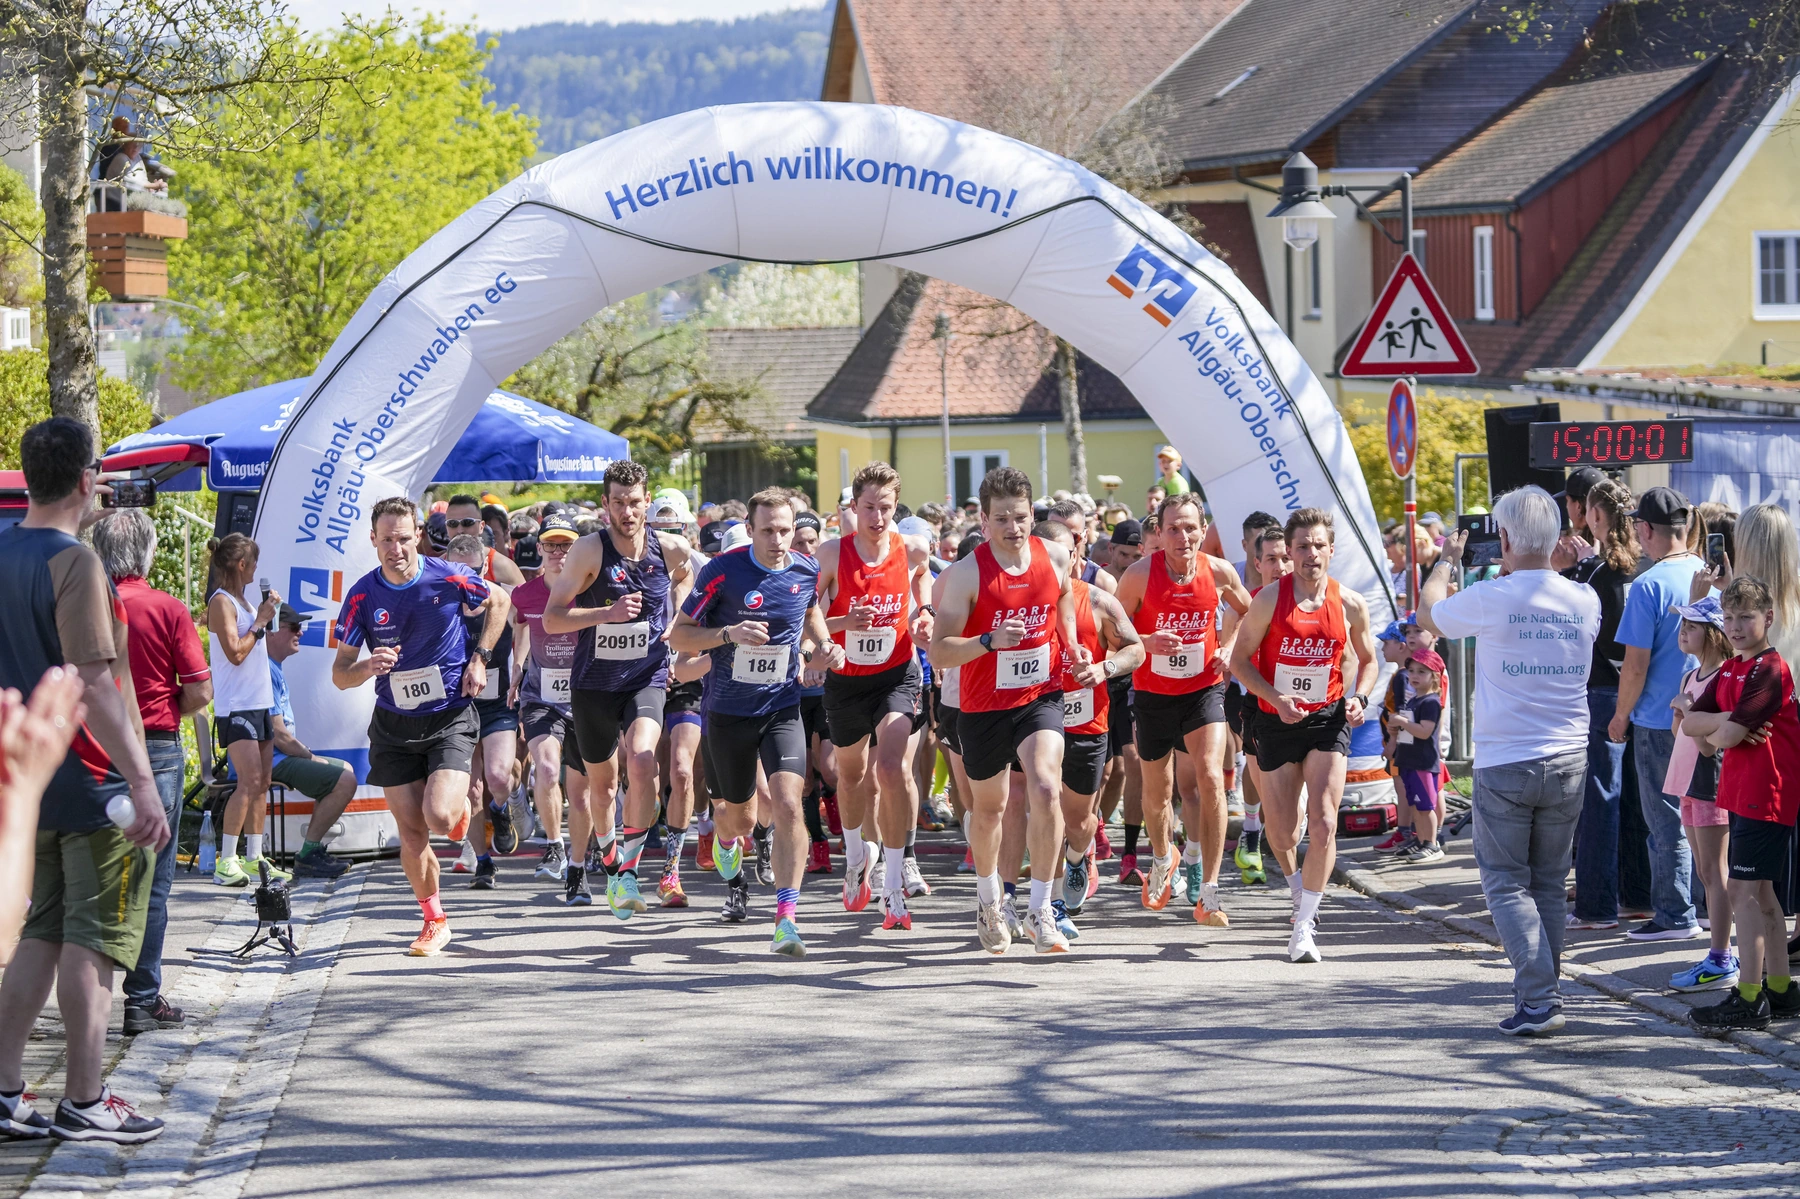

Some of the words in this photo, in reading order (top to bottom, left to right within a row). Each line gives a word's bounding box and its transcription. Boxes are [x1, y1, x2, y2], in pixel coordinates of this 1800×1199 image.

[604, 150, 754, 220] Herzlich
[764, 146, 1018, 219] willkommen!
[1203, 306, 1292, 420] Volksbank
[325, 303, 485, 555] Allgäu-Oberschwaben
[484, 271, 518, 304] eG
[1178, 330, 1302, 510] Allgäu-Obersch
[1552, 424, 1688, 462] 15:00:01
[222, 460, 270, 480] Augusti
[295, 416, 358, 545] Volksbank
[849, 593, 903, 605] SORT
[994, 603, 1050, 619] SPORT
[1156, 610, 1210, 621] SPORT
[991, 613, 1048, 627] HHKO
[1155, 619, 1208, 629] HASCHKO
[1508, 613, 1527, 624] Die
[1530, 613, 1584, 625] Nachricht
[597, 633, 648, 649] 20913
[1023, 628, 1047, 639] eam
[1519, 629, 1532, 640] ist
[1535, 629, 1555, 640] das
[1557, 629, 1578, 640] Ziel
[857, 638, 883, 653] 101
[1281, 636, 1337, 648] SPORT
[1279, 644, 1333, 656] HASCHKO
[748, 658, 777, 673] 184
[1011, 659, 1040, 676] 102
[1168, 655, 1188, 668] 98
[1502, 660, 1586, 677] kolumna.org
[402, 681, 431, 699] 180
[551, 679, 570, 692] 42
[1292, 677, 1312, 691] 96
[1064, 701, 1083, 716] 28
[1733, 864, 1756, 873] uhlsport
